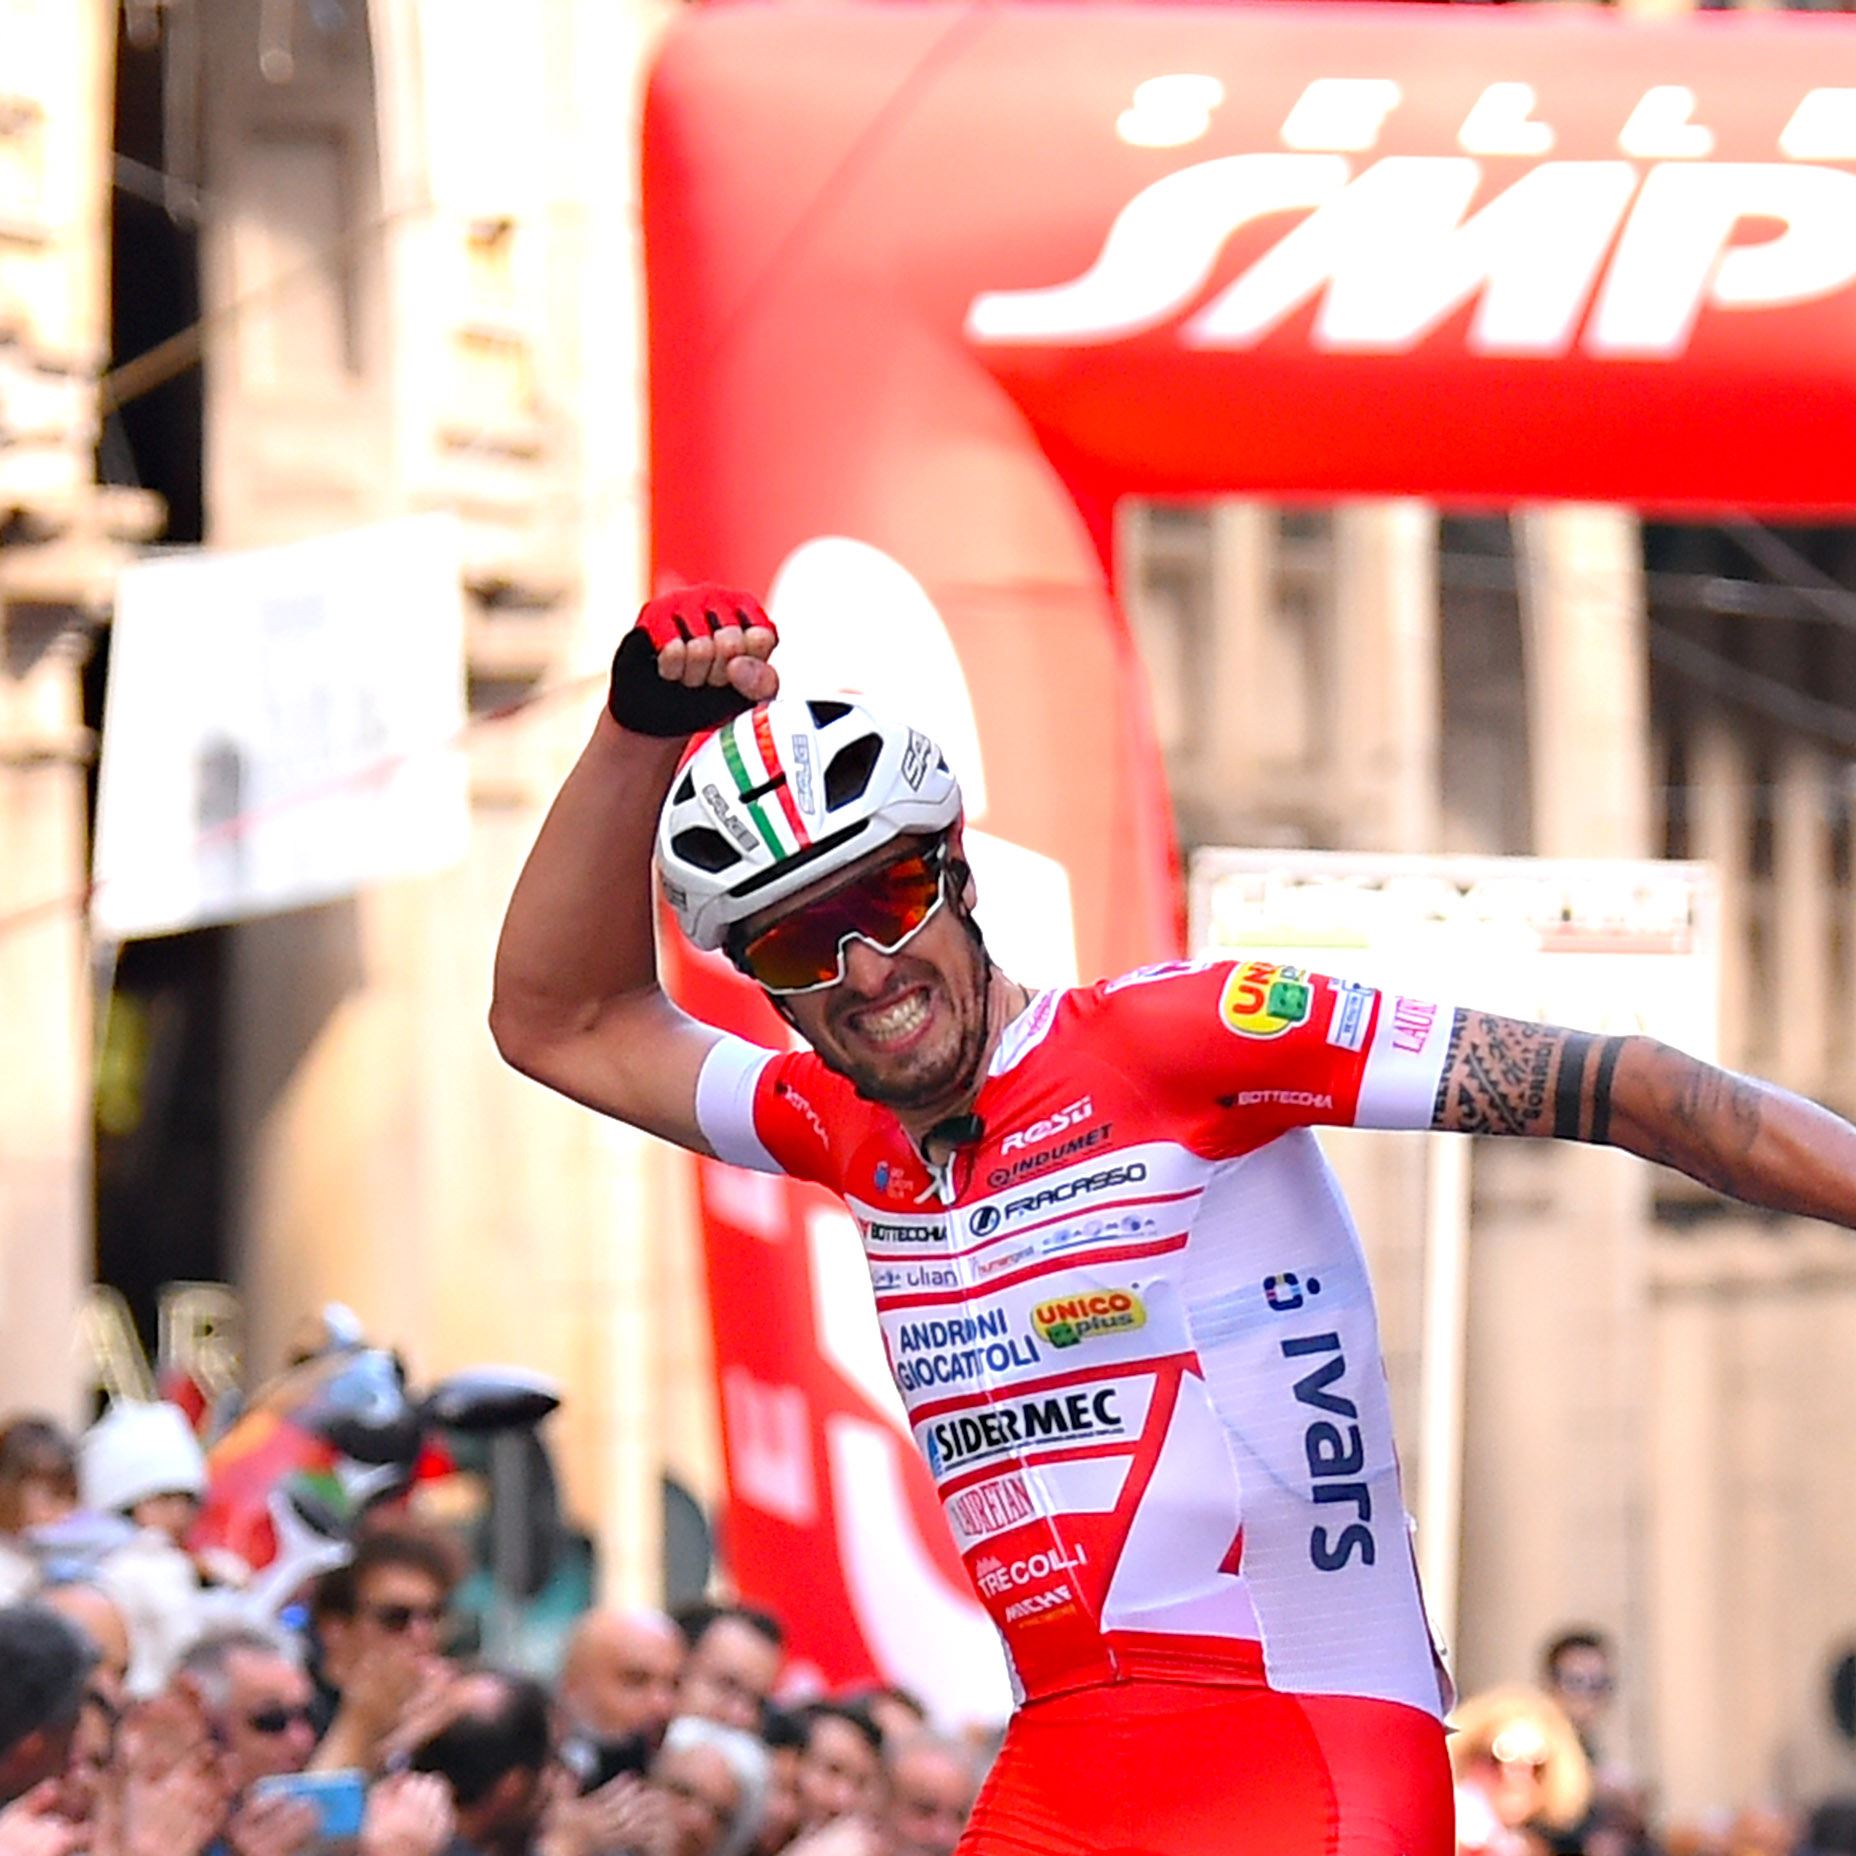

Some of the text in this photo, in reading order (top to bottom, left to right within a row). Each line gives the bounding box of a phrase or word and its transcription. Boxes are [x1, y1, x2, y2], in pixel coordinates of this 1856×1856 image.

[1238, 1090, 1333, 1110] BOTTECCHIA
[1012, 1124, 1113, 1176] INDUMET
[1005, 1163, 1147, 1220] FRACASSO
[1036, 1293, 1132, 1326] UNICO
[1075, 1311, 1136, 1338] plus
[935, 1389, 1122, 1463] SIDERMEC
